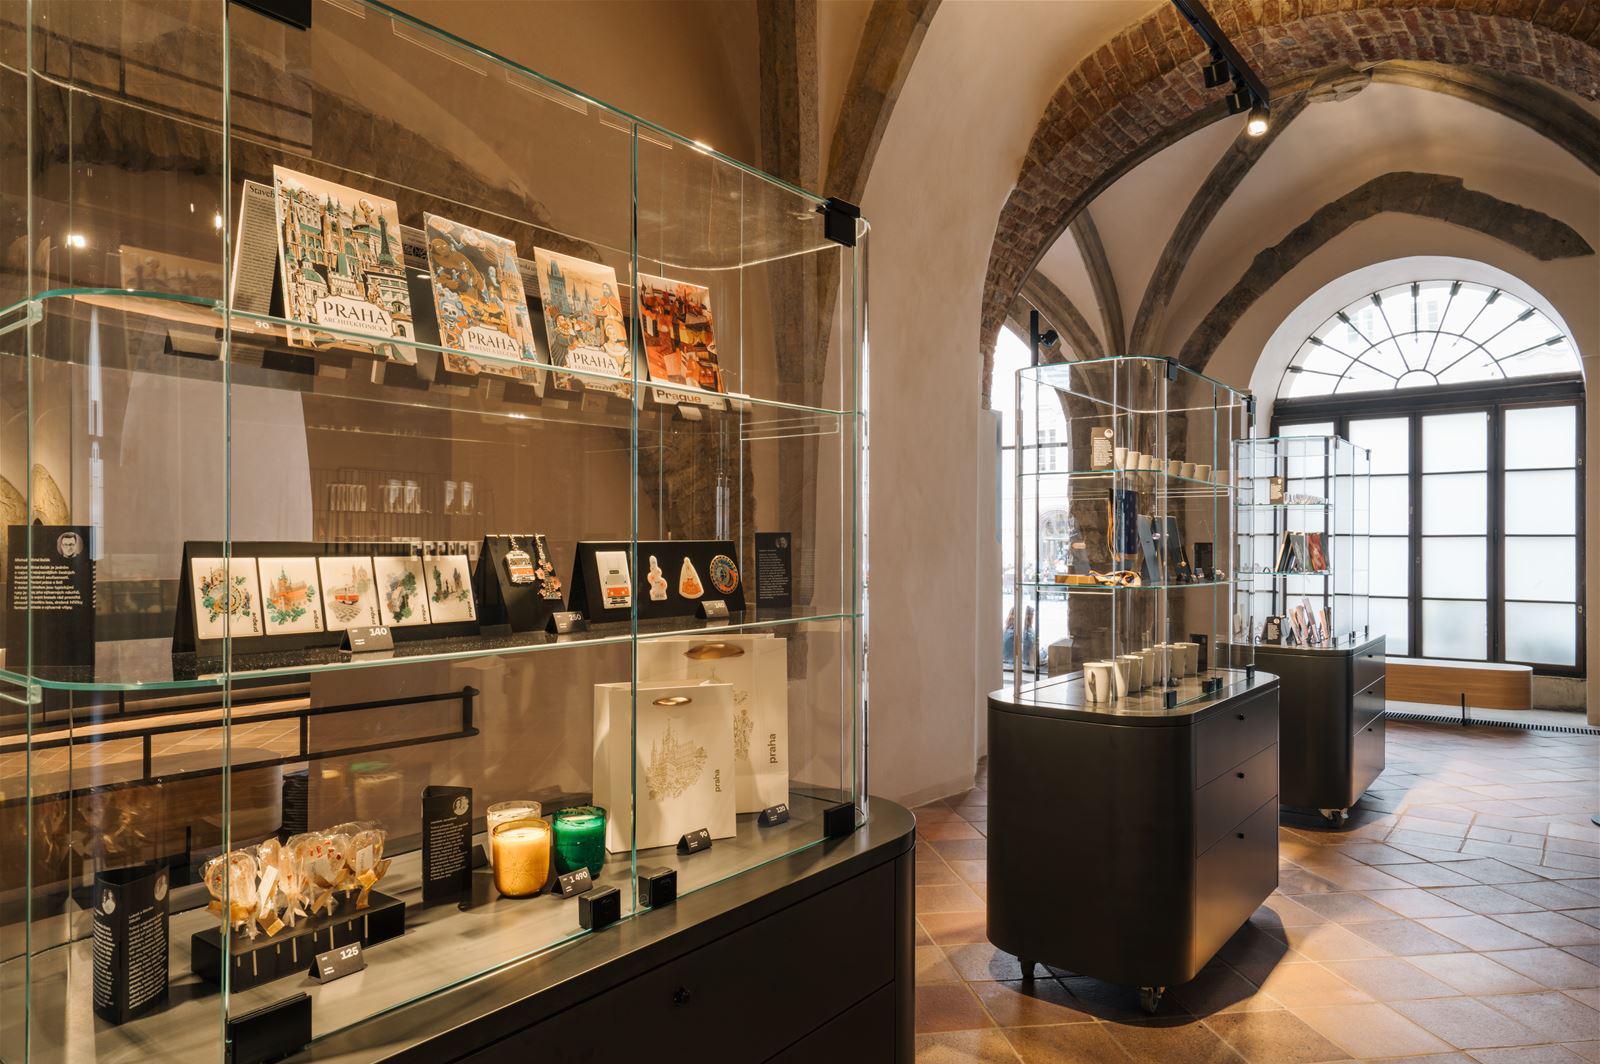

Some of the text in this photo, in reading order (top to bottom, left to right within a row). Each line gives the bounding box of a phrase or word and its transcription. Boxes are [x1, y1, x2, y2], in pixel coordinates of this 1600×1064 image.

[323, 301, 387, 325] PRAHA
[255, 320, 270, 330] 90
[467, 330, 516, 351] PRAHA
[573, 352, 615, 370] PRAHA
[656, 389, 702, 402] Prague
[368, 627, 387, 636] 140
[767, 733, 778, 764] praha
[713, 769, 722, 792] praha
[699, 830, 708, 838] 90
[340, 946, 359, 960] 125
